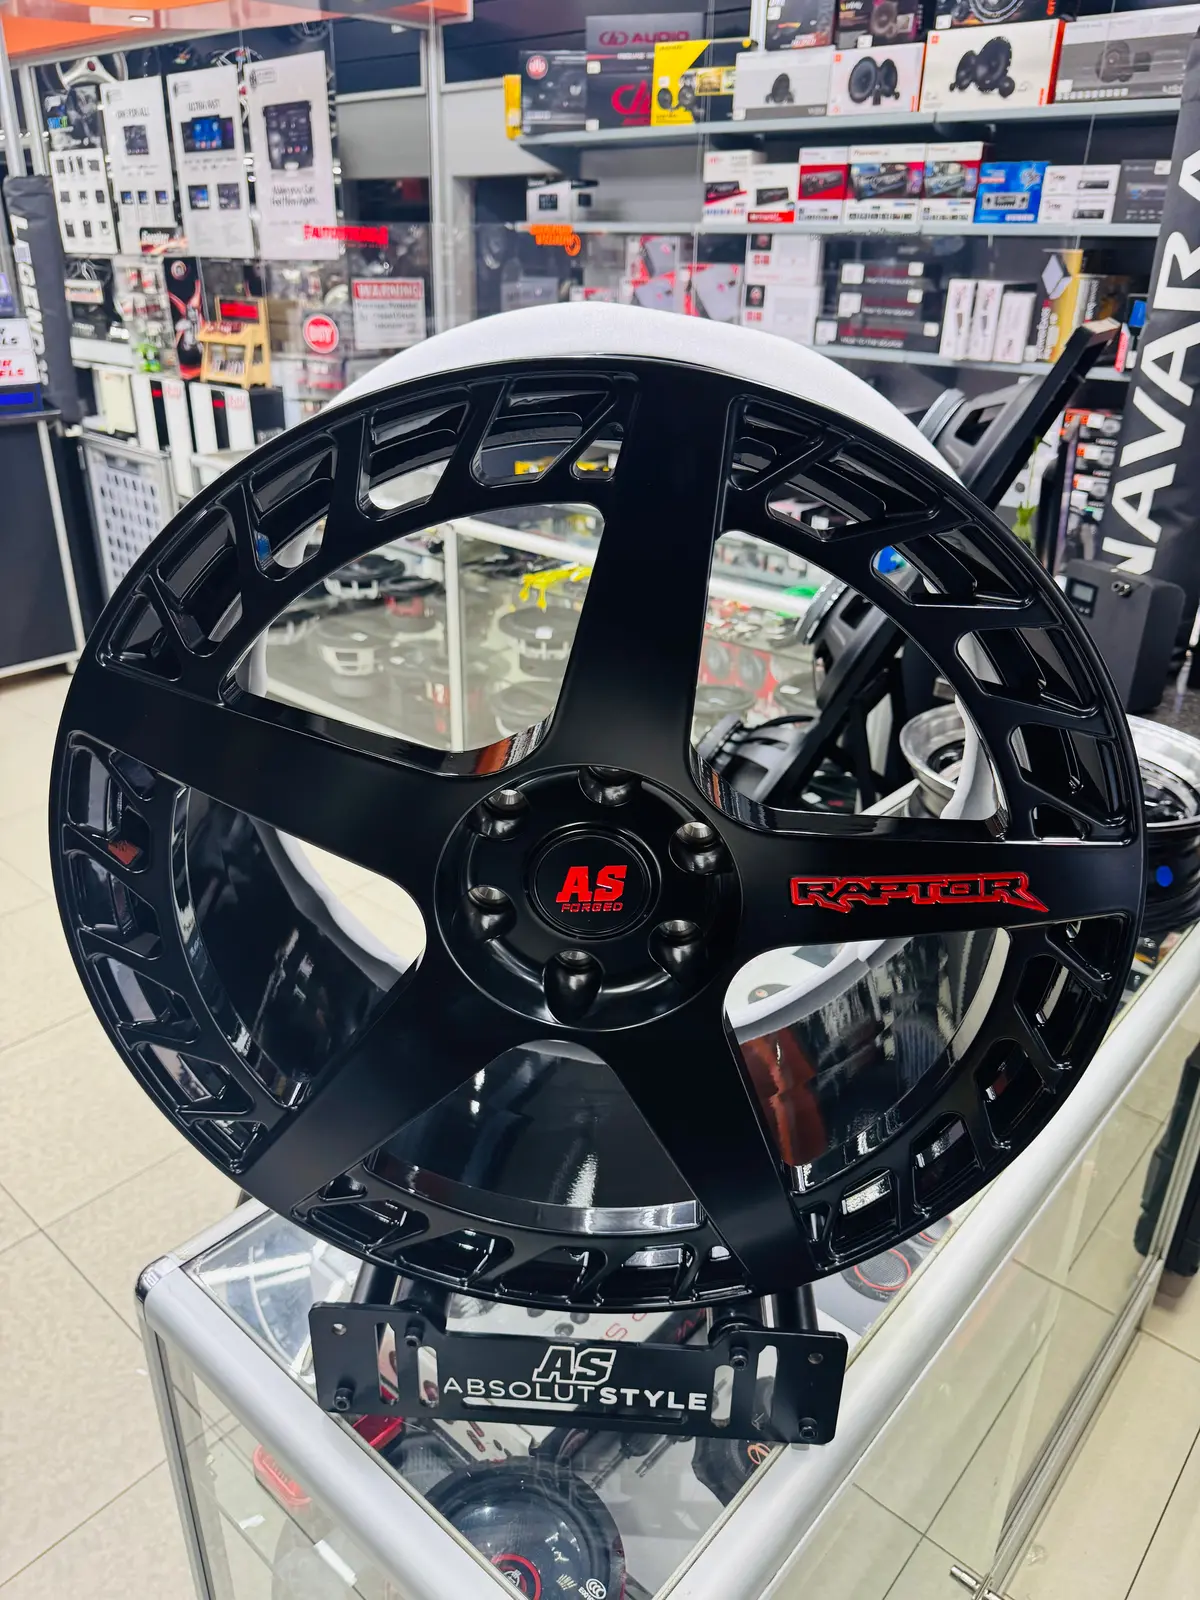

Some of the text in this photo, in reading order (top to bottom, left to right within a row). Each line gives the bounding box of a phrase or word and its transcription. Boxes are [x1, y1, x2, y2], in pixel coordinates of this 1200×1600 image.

[357, 283, 419, 299] WARNING
[556, 865, 628, 902] AS
[790, 872, 1049, 913] RAPTOR
[561, 902, 624, 913] FORGED
[532, 1345, 617, 1385] AS
